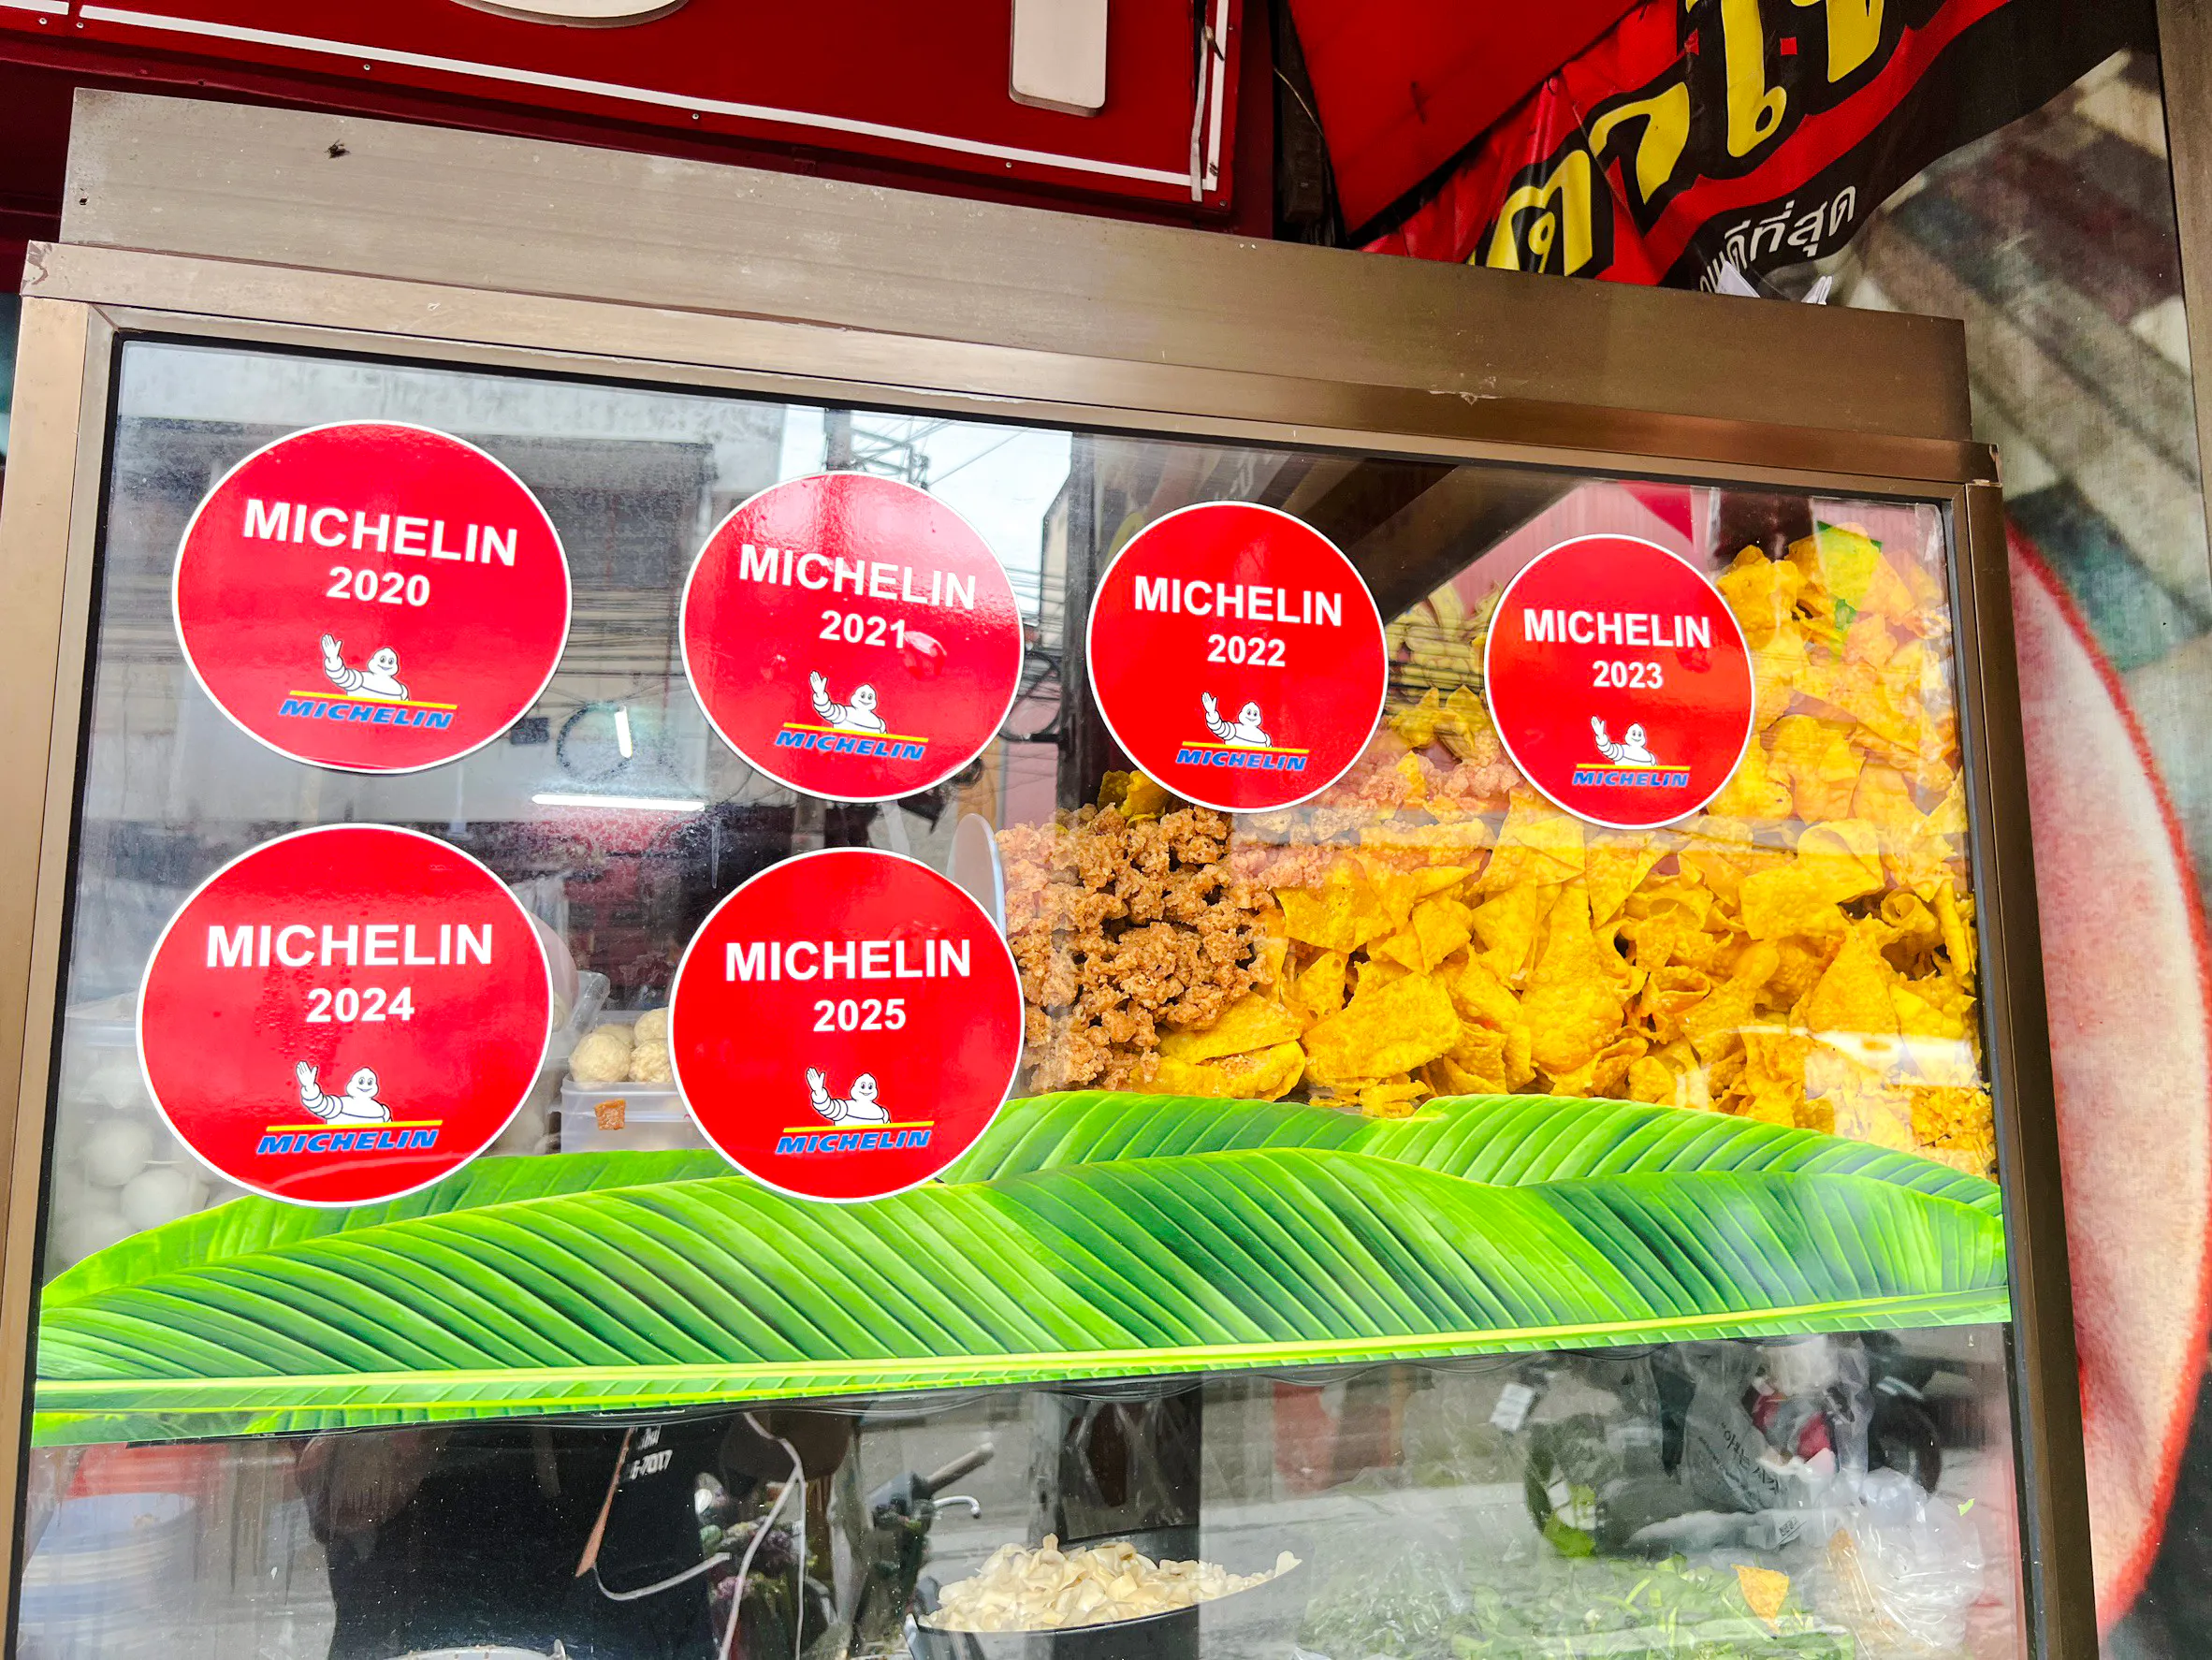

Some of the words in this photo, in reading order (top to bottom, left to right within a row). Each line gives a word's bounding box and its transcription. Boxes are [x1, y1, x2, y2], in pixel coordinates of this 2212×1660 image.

[243, 499, 517, 566] MICHELIN
[326, 566, 430, 606] 2020
[739, 544, 976, 610] MICHELIN
[1135, 575, 1342, 627] MICHELIN
[819, 610, 906, 649] 2021
[1523, 608, 1710, 648] MICHELIN
[1207, 633, 1286, 667] 2022
[1593, 660, 1664, 690] 2023
[278, 698, 454, 730] MICHELIN
[774, 730, 926, 762] MICHELIN
[1175, 749, 1308, 772] MICHELIN
[1572, 771, 1690, 788] MICHELIN
[207, 924, 492, 968] MICHELIN
[726, 939, 970, 982] MICHELIN
[306, 986, 415, 1023] 2024
[813, 998, 907, 1032] 2025
[255, 1129, 439, 1156] MICHELIN
[775, 1129, 932, 1155] MICHELIN
